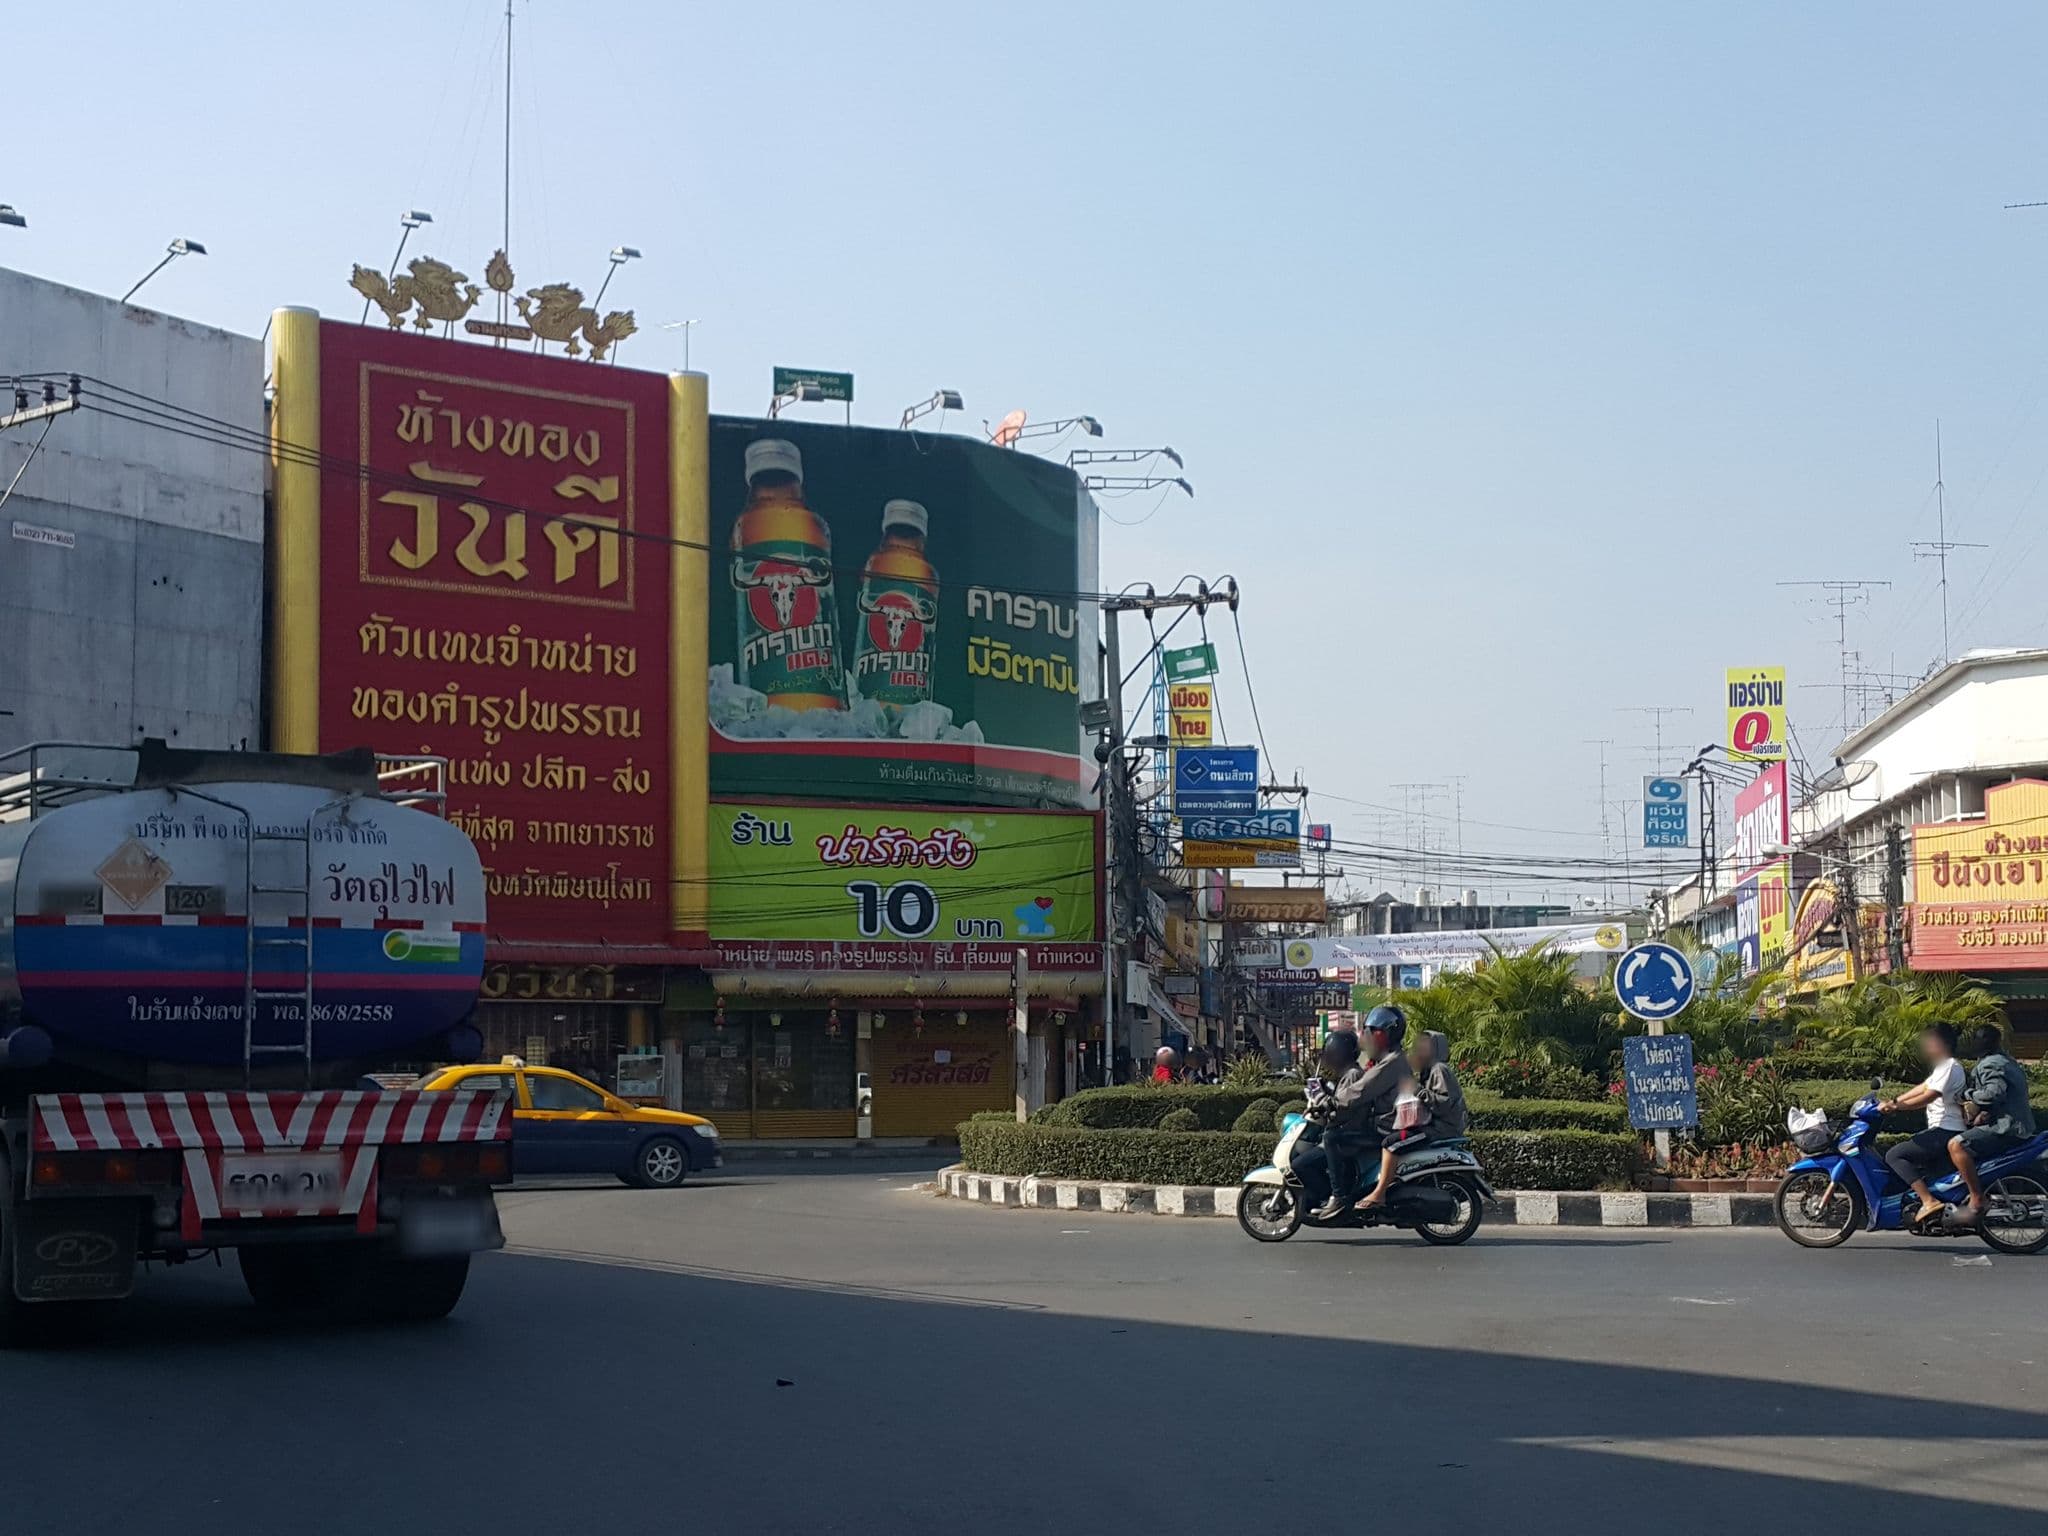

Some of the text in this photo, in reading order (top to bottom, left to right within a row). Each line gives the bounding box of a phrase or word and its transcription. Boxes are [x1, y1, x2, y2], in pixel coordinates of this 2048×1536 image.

[396, 389, 600, 466] ห้างทอง
[378, 460, 619, 589] วันดี
[359, 612, 637, 677] ตัวแทนจำหน่าย
[1729, 673, 1783, 708] แอร์บ้าน
[352, 682, 641, 744] ทองคำรูปพรรณ
[1176, 714, 1207, 735] ไทย
[612, 758, 650, 794] ส่ง
[1209, 769, 1254, 782] ถนนสีขาว
[1647, 817, 1685, 830] ท็อป
[1650, 804, 1683, 817] แว่น
[135, 815, 187, 839] บริษัท
[527, 820, 654, 848] จากเยาวราช
[731, 811, 980, 870] ร้าน น่ารักจัง
[1645, 831, 1686, 845] เจริญ
[1931, 850, 2048, 888] ปีนังเยา
[322, 862, 455, 920] วัตถุไวไฟ
[846, 879, 1006, 940] 10 บาท
[1308, 903, 1321, 919] 2
[1919, 906, 1969, 926] จำหน่าย
[1958, 925, 1996, 947] รับซื้อ
[777, 947, 815, 963] เพชร
[820, 948, 924, 970] ทองรูปพรรณ
[1036, 946, 1096, 964] ทำแหวน
